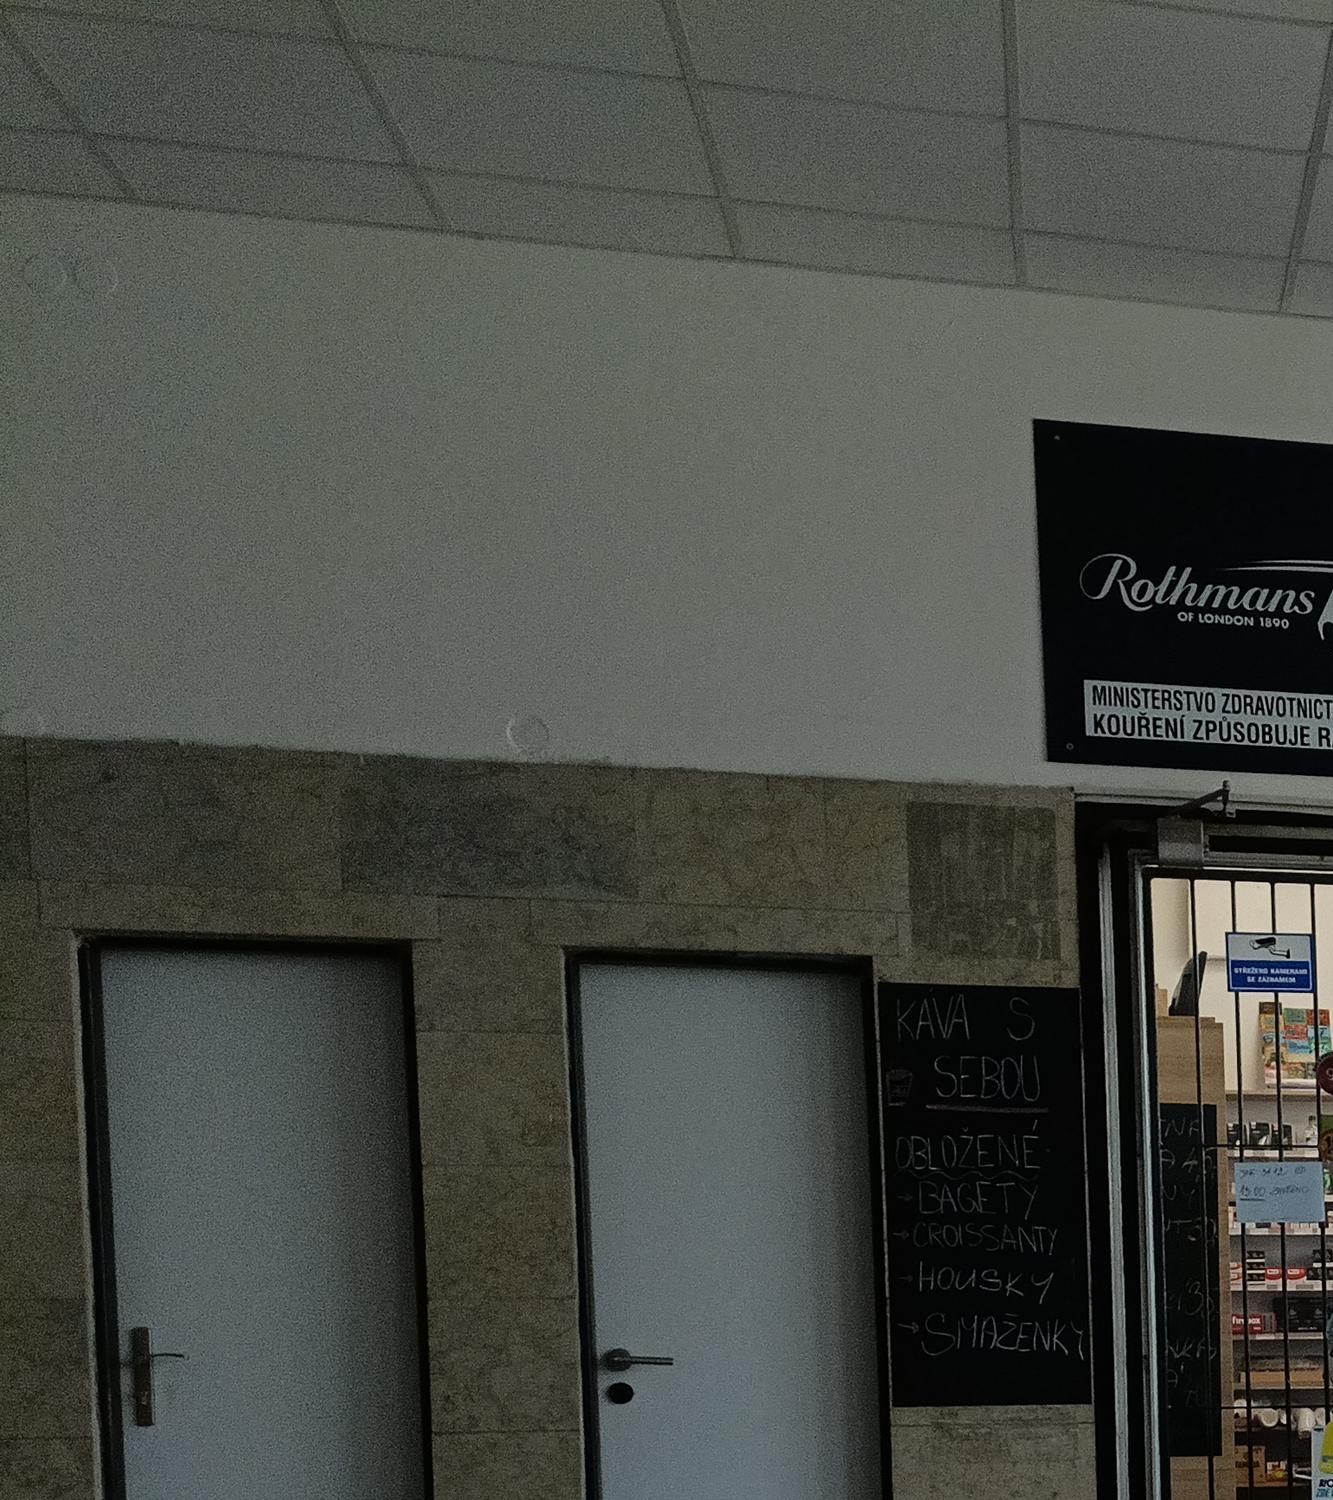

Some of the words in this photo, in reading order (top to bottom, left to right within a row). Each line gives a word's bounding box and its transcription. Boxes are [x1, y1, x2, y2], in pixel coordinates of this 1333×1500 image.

[1079, 552, 1316, 615] Rothmans
[1177, 611, 1195, 623] OF
[1199, 612, 1255, 627] LONDON
[1259, 616, 1290, 629] 1890
[1092, 685, 1216, 713] MINISTERSTVO
[1092, 708, 1186, 741] KOUŘENÍ
[1192, 714, 1311, 747] ZPŮSOBUJE
[896, 987, 970, 1041] KÁVA
[1008, 996, 1036, 1041] S
[934, 1054, 1041, 1102] SEBOU
[895, 1119, 1041, 1170] OBLOŽENÉ
